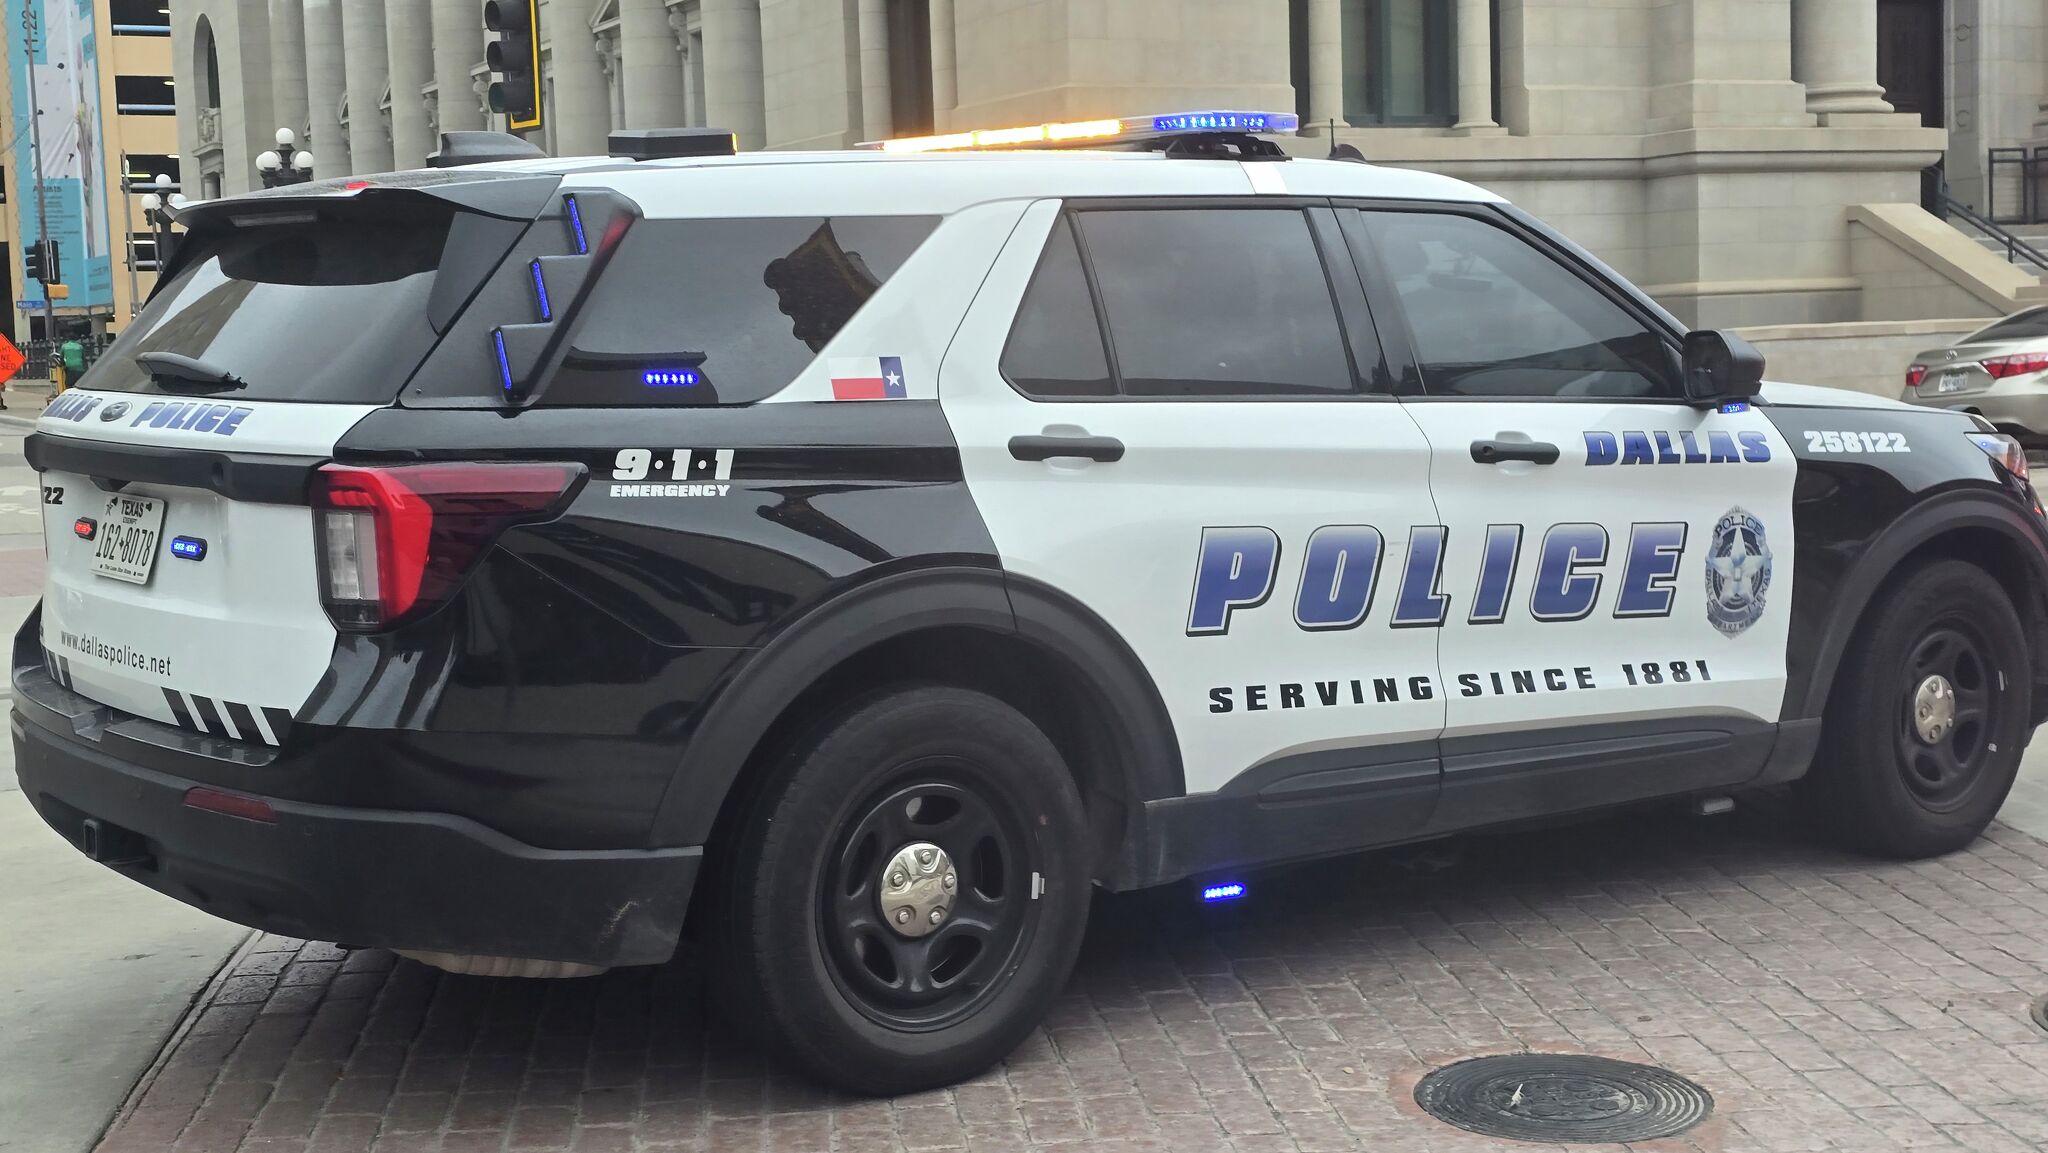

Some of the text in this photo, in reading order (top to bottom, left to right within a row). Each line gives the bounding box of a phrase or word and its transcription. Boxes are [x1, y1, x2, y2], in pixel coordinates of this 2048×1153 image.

[129, 402, 254, 436] POLICE
[1582, 430, 1772, 466] DALLAS
[1803, 430, 1911, 453] 258122
[44, 486, 64, 504] 22
[610, 484, 731, 497] EMERGENCY
[121, 499, 144, 517] TEXAS
[1714, 515, 1764, 537] POLICE
[1185, 522, 1689, 637] POLICE
[61, 630, 171, 677] www.dallaspolice.net
[1209, 660, 1711, 714] SERVING SINCE 1881
